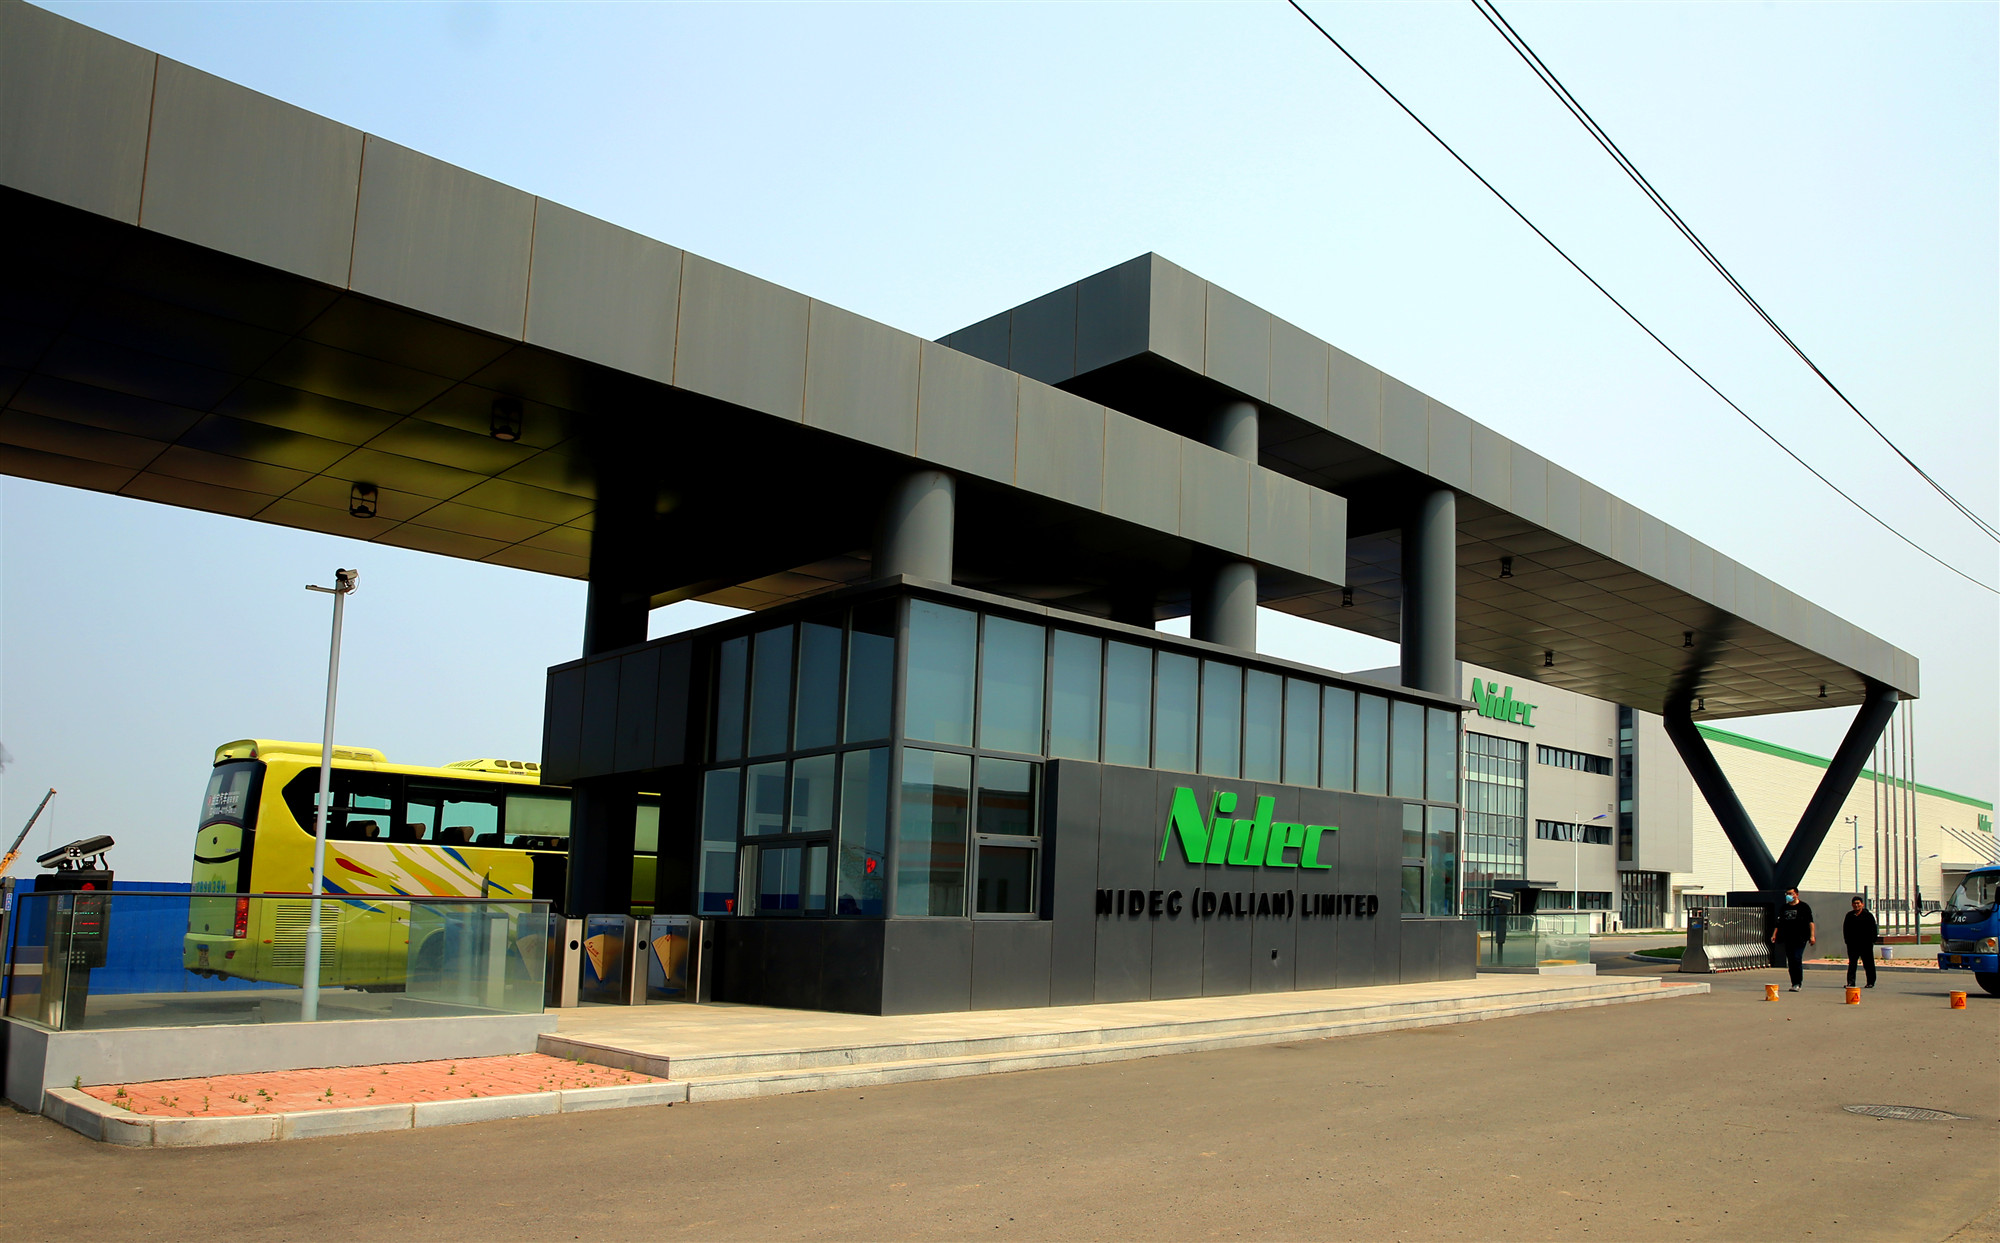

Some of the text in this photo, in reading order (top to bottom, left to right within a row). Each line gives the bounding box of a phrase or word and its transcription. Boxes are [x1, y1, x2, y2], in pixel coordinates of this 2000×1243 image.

[1468, 677, 1539, 728] Nidec
[1158, 786, 1340, 869] Nidec
[1096, 887, 1379, 919] NIDEC (DALIAN) LIMITED
[1953, 915, 1967, 923] JAC
